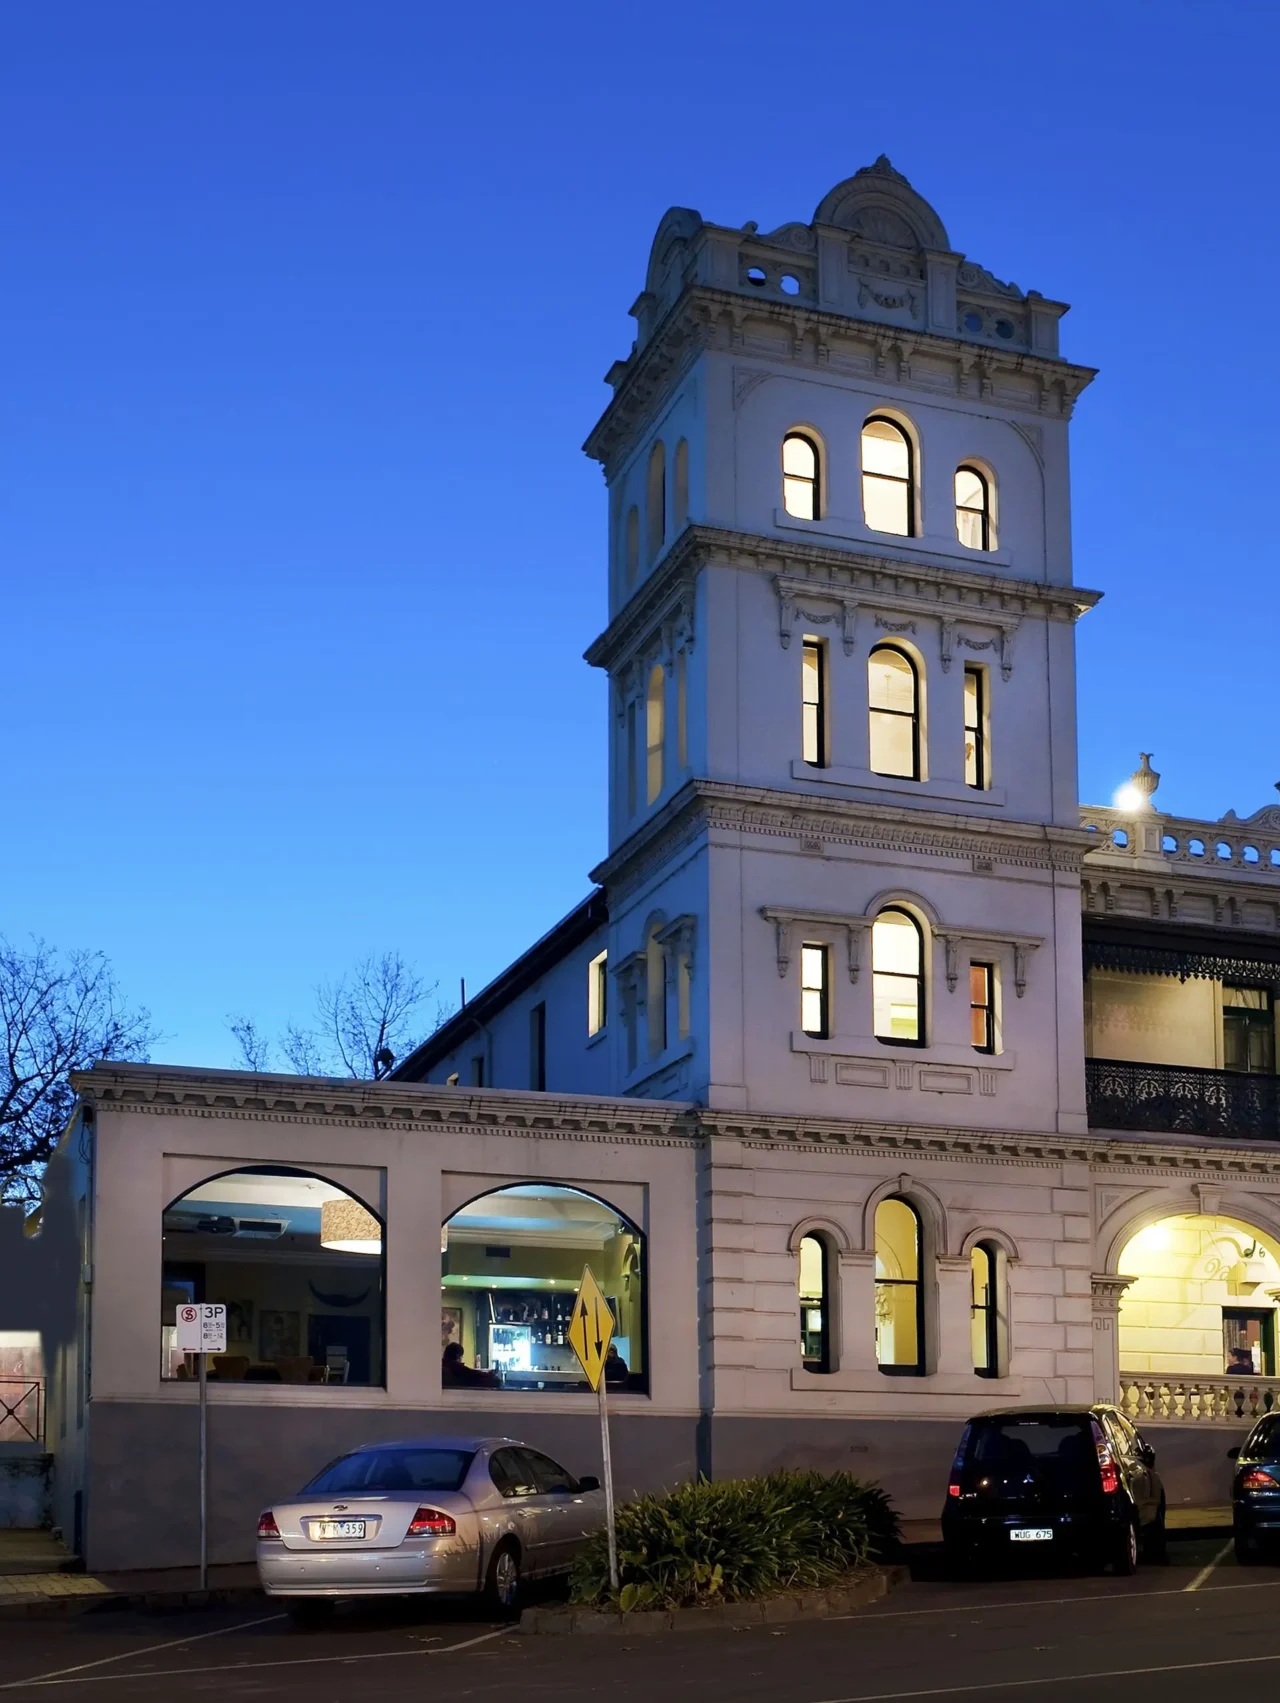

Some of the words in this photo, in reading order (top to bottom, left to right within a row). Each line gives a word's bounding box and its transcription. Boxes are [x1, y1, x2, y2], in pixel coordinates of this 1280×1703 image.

[204, 1306, 224, 1318] 3P
[345, 1523, 363, 1534] 359
[1014, 1531, 1031, 1539] WUG
[1036, 1530, 1052, 1539] 675
